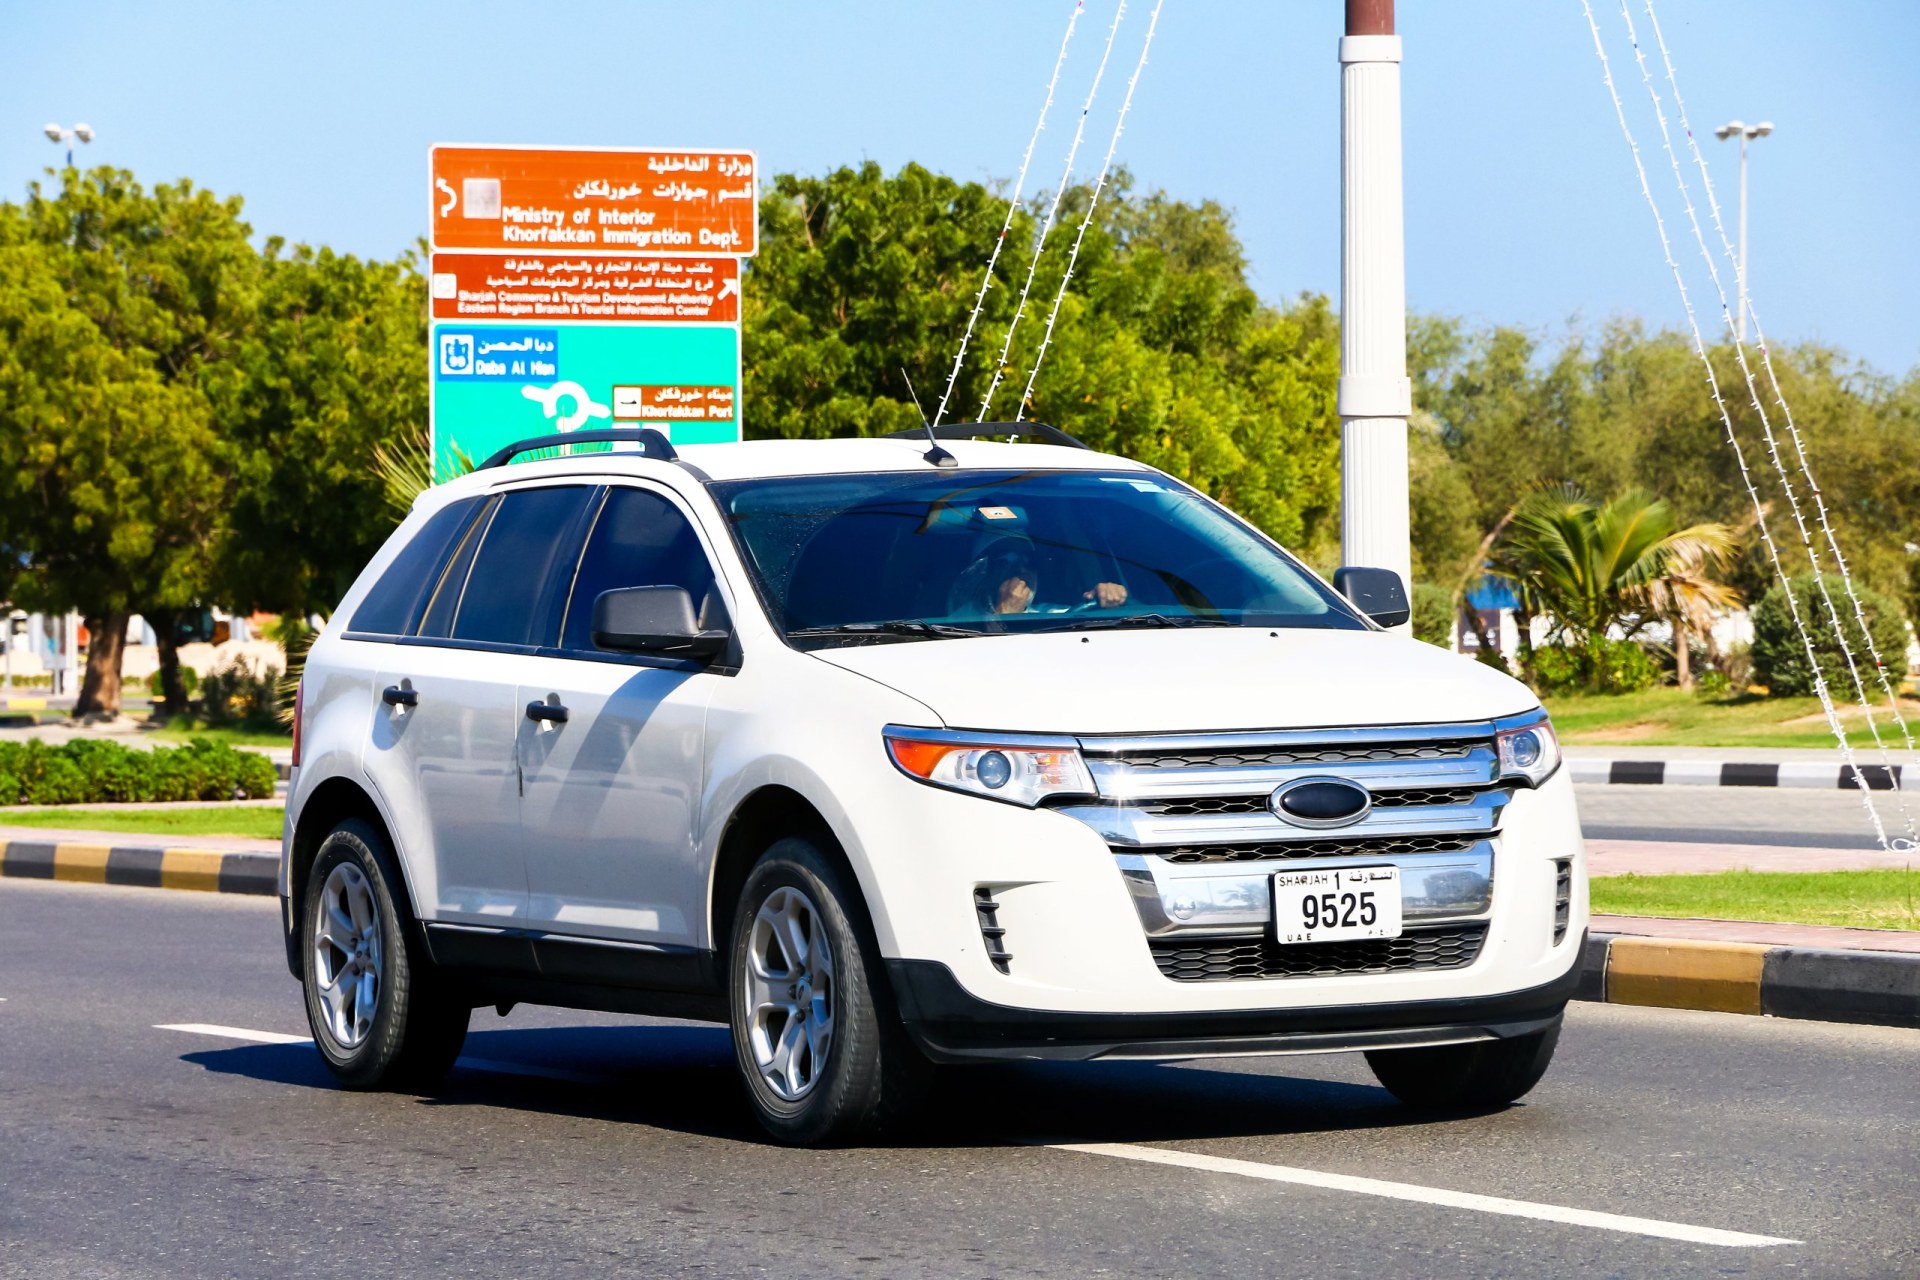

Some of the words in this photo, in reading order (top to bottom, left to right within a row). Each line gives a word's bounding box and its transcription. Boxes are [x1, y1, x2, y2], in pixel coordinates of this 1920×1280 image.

[648, 156, 709, 175] الداخلية
[717, 157, 752, 177] وزارة
[573, 179, 642, 200] خورفكان
[653, 181, 708, 201] جوازات
[718, 182, 752, 203] قسم
[502, 207, 564, 226] Ministry
[573, 208, 591, 224] of
[599, 208, 656, 225] Interior
[503, 226, 596, 244] Khorfakkan
[603, 227, 692, 247] Immigration
[699, 228, 742, 248] Dept.
[458, 290, 497, 303] Sharjah
[498, 290, 551, 303] Commerce
[552, 291, 560, 302] &
[561, 291, 601, 303] Tourism
[602, 292, 667, 305] Development
[668, 293, 714, 307] Authority
[457, 301, 497, 313] Eastern
[498, 302, 533, 316] Region
[535, 302, 570, 314] Branch
[571, 303, 579, 314] &
[580, 303, 615, 315] Tourist
[617, 304, 675, 315] Information
[676, 305, 709, 316] Center
[511, 360, 526, 375] Al
[641, 405, 705, 418] Khorfakkan
[708, 405, 734, 418] Port
[1333, 872, 1340, 890] 1
[1302, 891, 1377, 930] 9525
